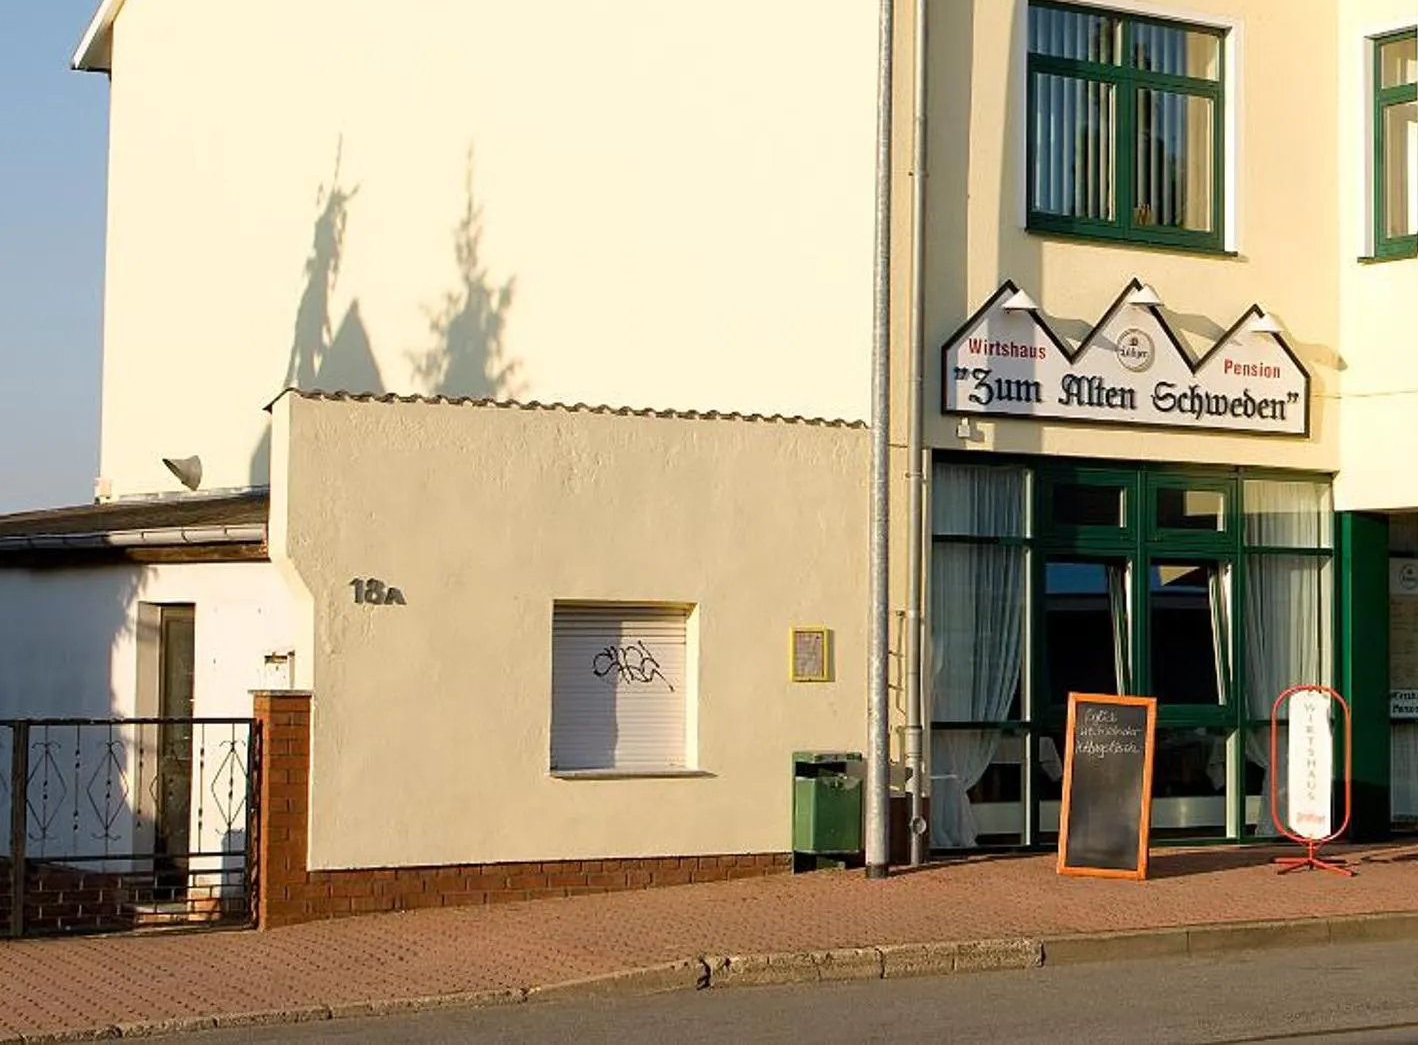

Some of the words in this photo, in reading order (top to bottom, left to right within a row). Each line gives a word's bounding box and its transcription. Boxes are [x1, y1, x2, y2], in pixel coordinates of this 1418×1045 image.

[968, 338, 1047, 361] Wirtshaus
[1223, 358, 1281, 379] Pension
[1057, 373, 1137, 410] Alten
